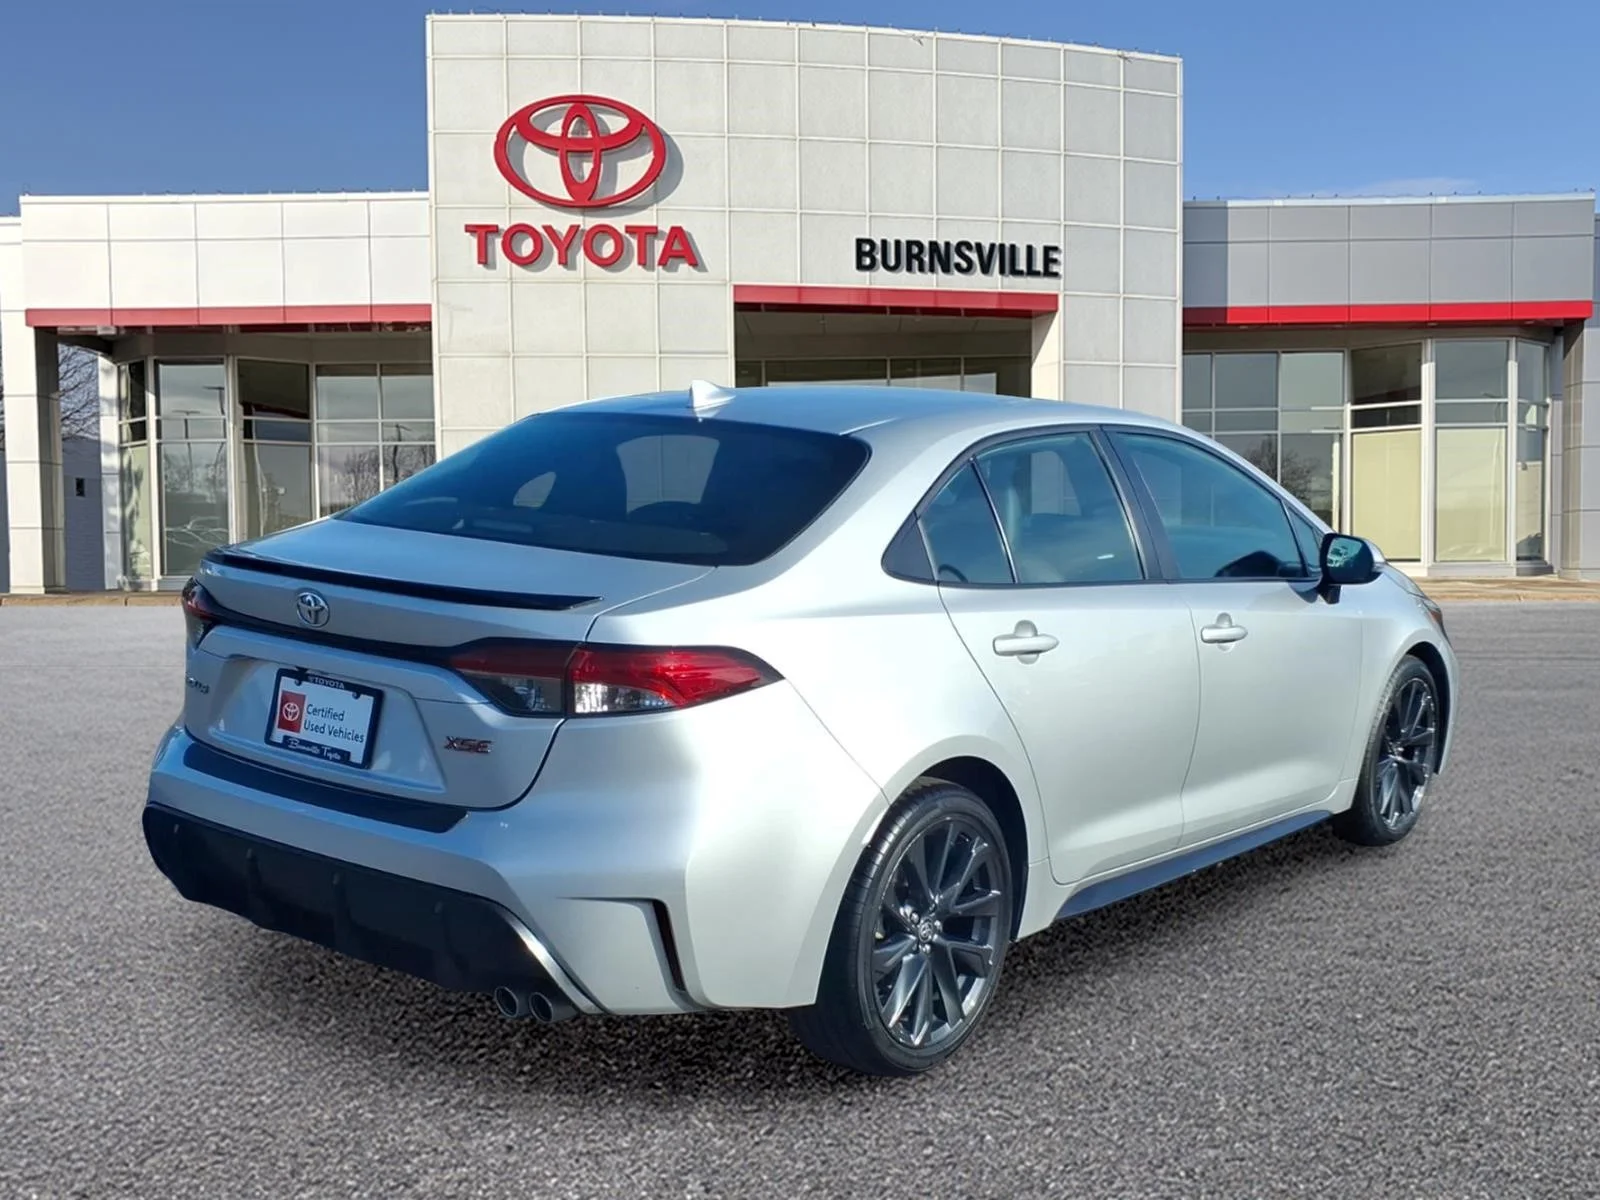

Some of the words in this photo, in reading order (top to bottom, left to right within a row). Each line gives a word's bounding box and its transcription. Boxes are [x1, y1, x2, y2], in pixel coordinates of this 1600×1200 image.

[464, 224, 699, 269] TOYOTA
[855, 238, 1061, 278] BURNSVILLE
[315, 677, 345, 690] TOYOTA
[306, 704, 345, 721] Certified
[303, 720, 325, 734] Used
[328, 724, 364, 743] Vehicles
[444, 736, 492, 754] XSE
